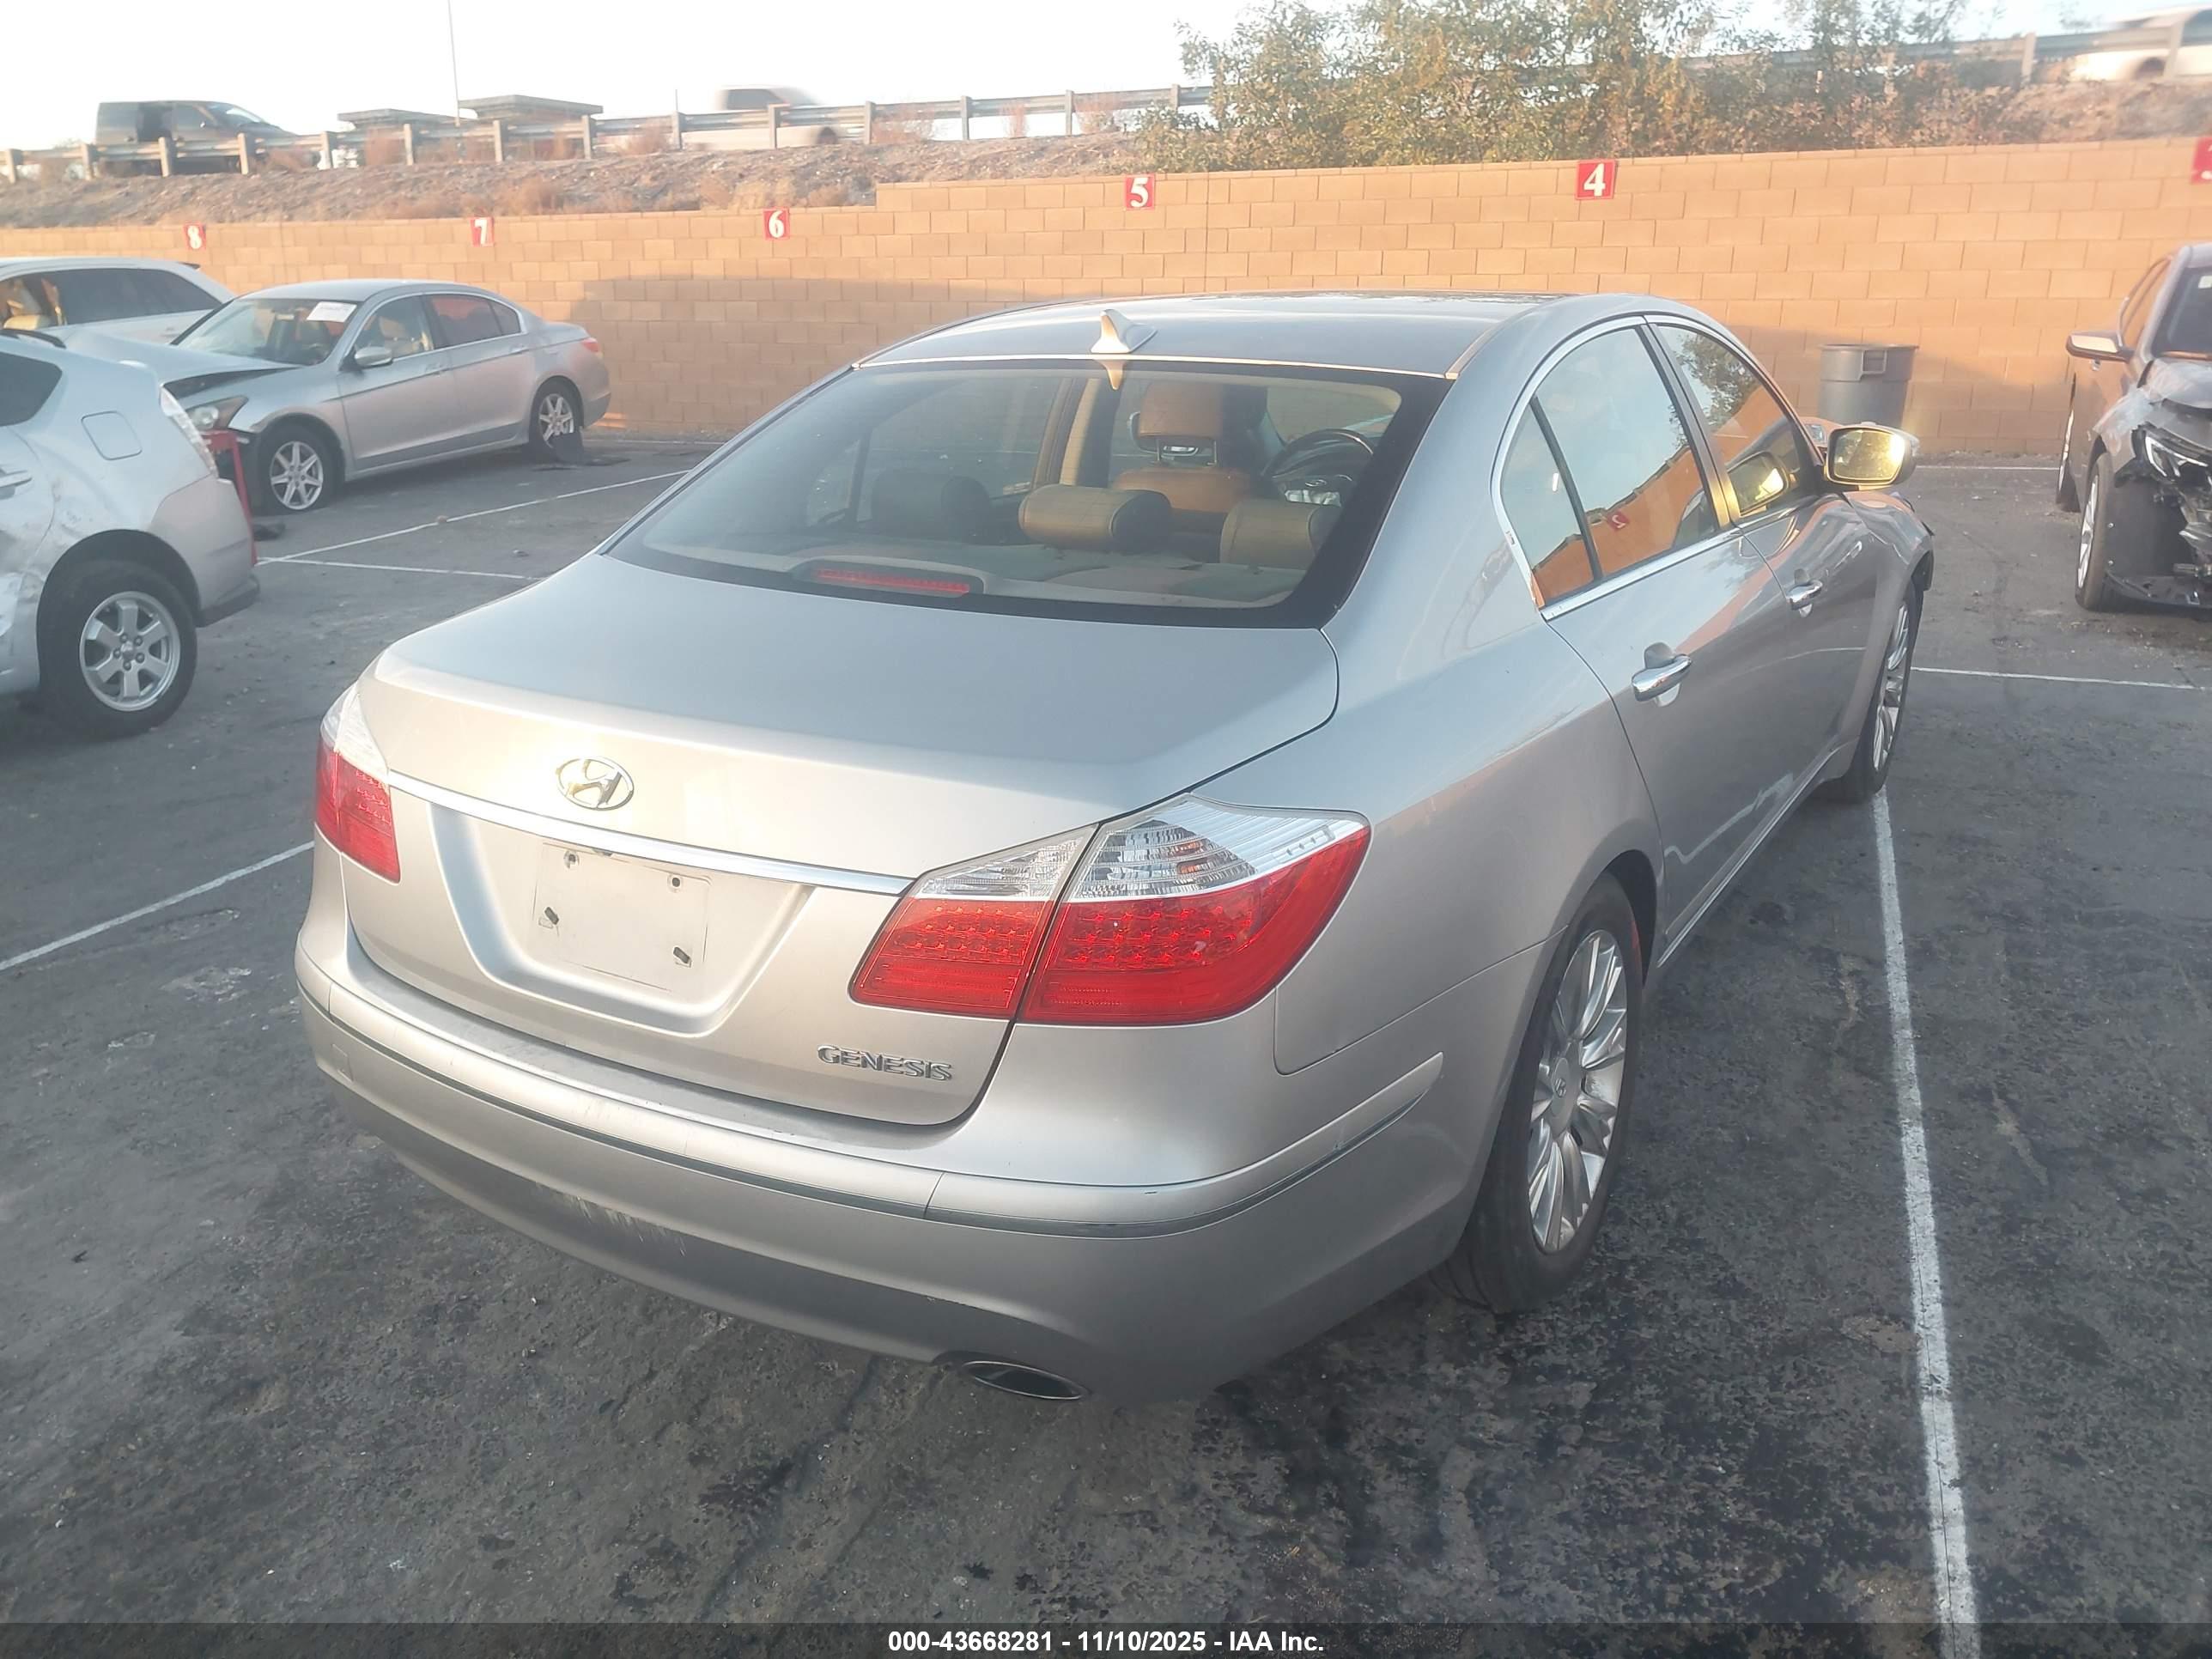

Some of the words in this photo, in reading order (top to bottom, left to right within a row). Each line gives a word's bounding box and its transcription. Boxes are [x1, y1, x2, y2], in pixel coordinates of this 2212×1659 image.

[1129, 177, 1149, 208] 5
[1584, 163, 1606, 198] 4
[187, 225, 203, 250] 8
[474, 218, 489, 246] 7
[768, 210, 785, 239] 6
[817, 1044, 952, 1081] GENESIS
